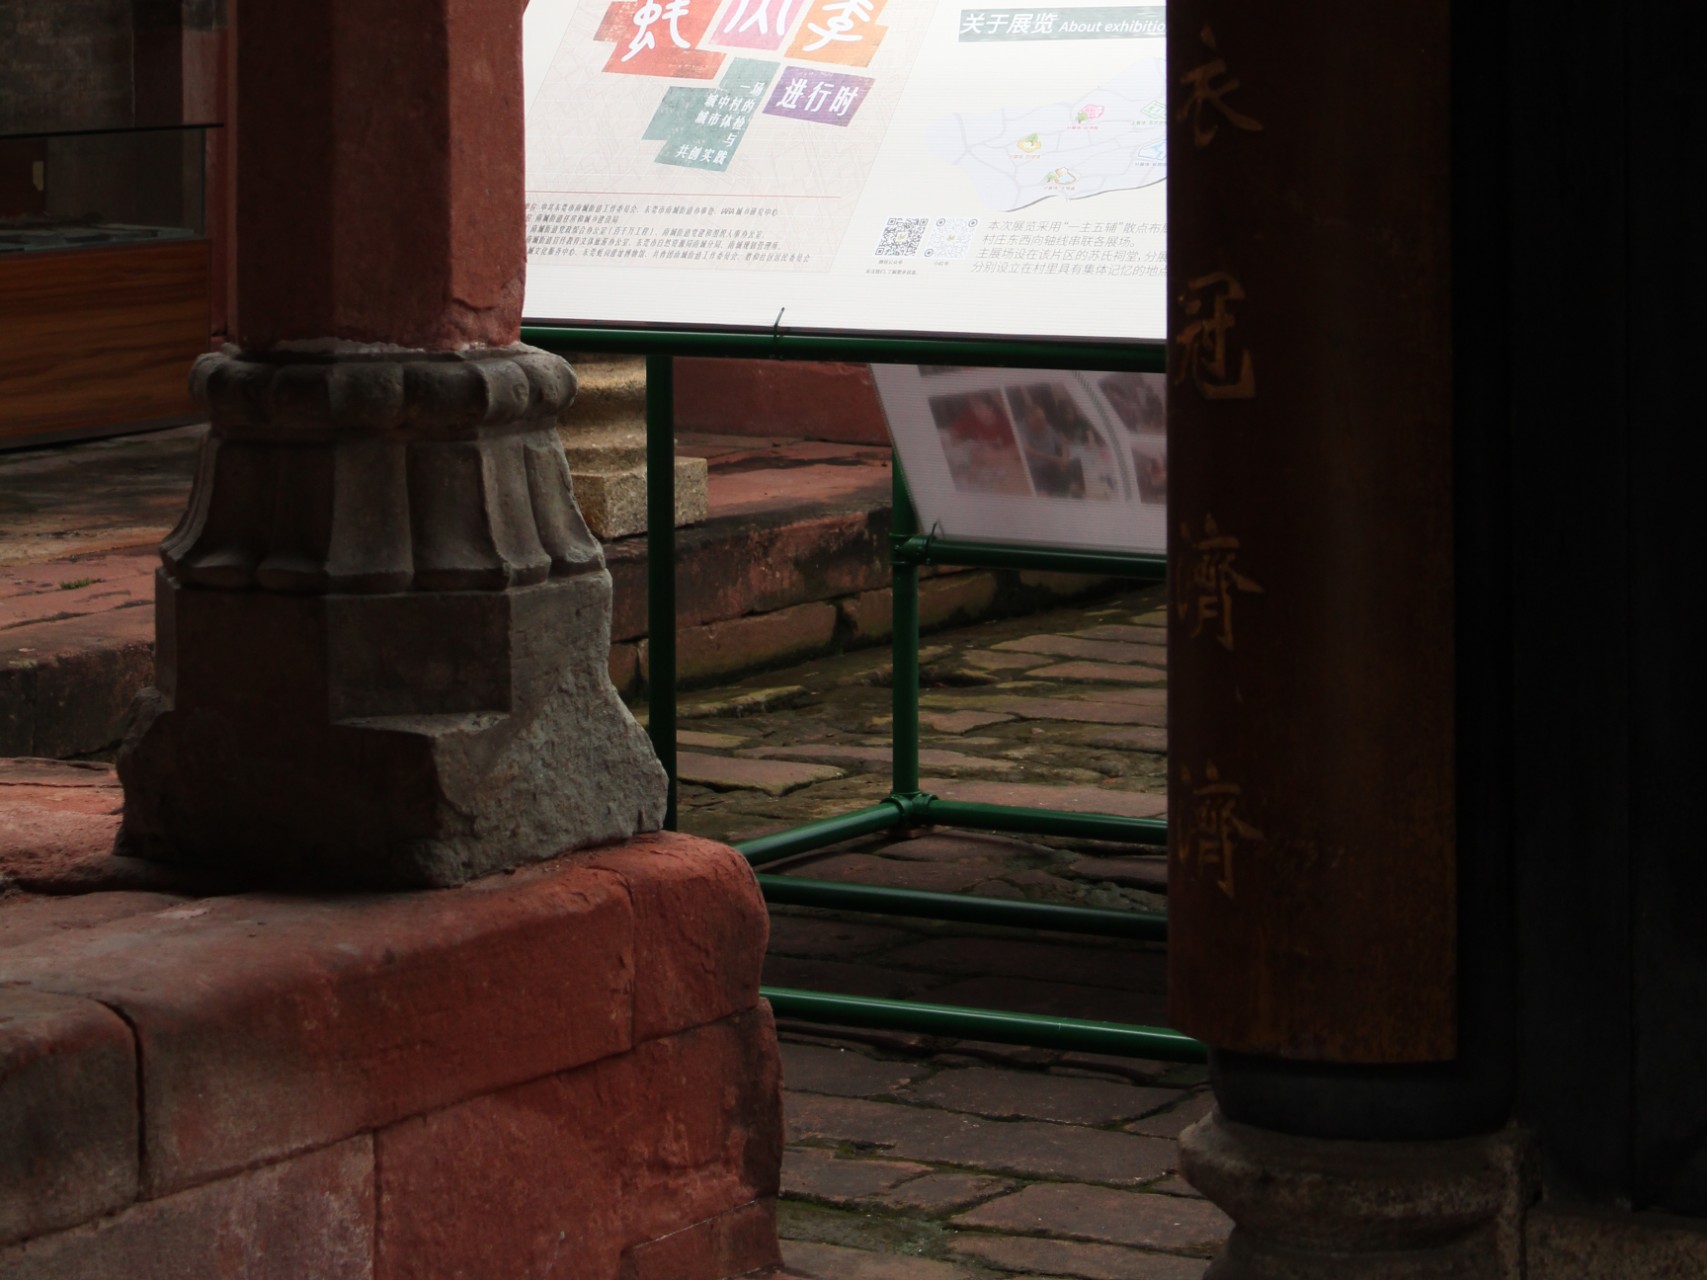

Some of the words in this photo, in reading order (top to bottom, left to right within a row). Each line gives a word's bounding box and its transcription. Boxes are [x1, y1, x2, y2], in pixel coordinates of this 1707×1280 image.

[960, 13, 1059, 34] 关于展览
[1059, 21, 1102, 33] About
[705, 93, 755, 113] 城中村的
[776, 78, 858, 116] 进行时
[695, 111, 746, 130] 城市体检
[723, 132, 738, 147] 与
[675, 144, 728, 165] 共创实践
